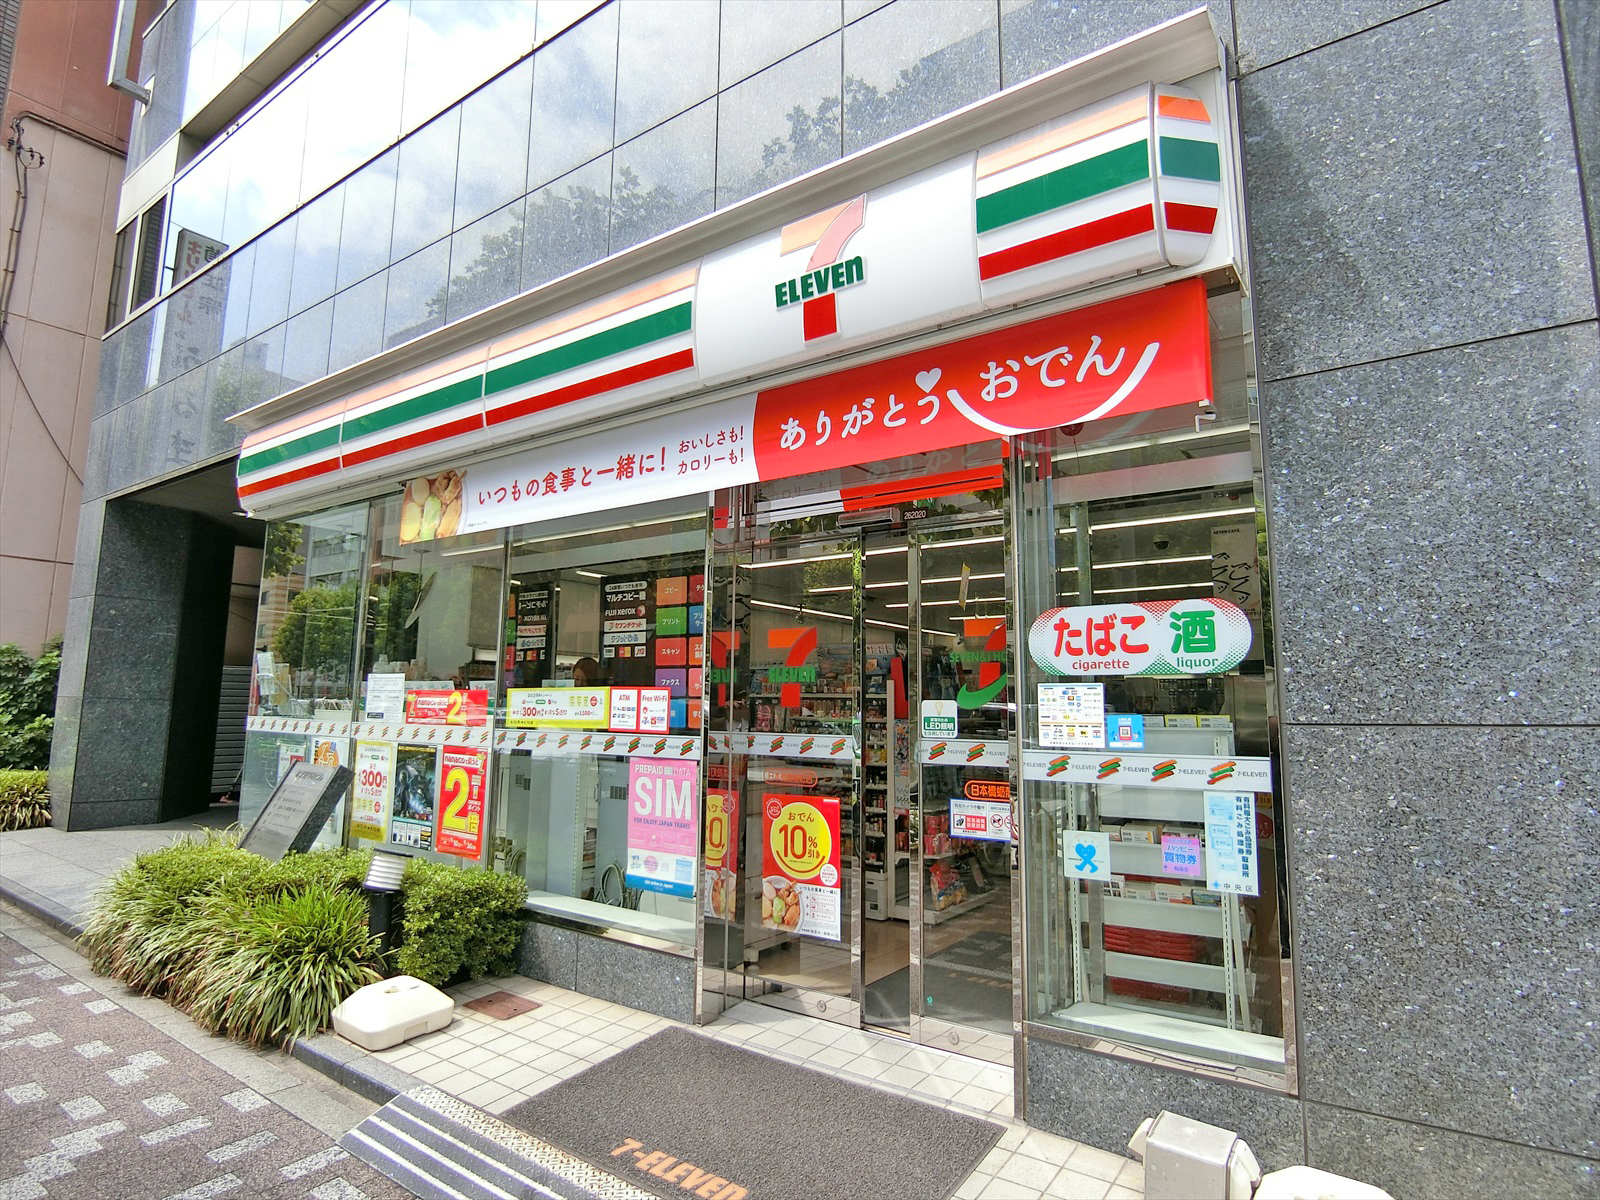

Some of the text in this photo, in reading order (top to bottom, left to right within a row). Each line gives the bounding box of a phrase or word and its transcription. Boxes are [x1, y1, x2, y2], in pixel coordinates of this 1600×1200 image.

[780, 193, 866, 342] 7
[780, 334, 1126, 452] ありがとう おでん
[678, 425, 744, 454] おいしさも！
[677, 447, 744, 476] カロリーも！
[478, 446, 666, 505] いつもの食事と一緒に！
[903, 510, 927, 520] 262020
[617, 608, 637, 616] xerox
[1053, 612, 1150, 658] たばこ
[1169, 609, 1217, 655] 酒
[768, 626, 818, 709] 7
[1072, 659, 1130, 671] cigarette
[1176, 656, 1219, 669] liquor
[654, 694, 667, 702] Wi-Fi
[924, 722, 954, 730] LED照明
[634, 763, 664, 775] PREPAID
[673, 766, 691, 777] DATA
[442, 766, 470, 832] 2
[634, 775, 692, 820] SIM
[643, 818, 658, 826] ENJOY
[787, 811, 815, 823] おでん
[1235, 795, 1245, 855] 有料ごみ処理券
[1167, 844, 1194, 853] ハッピー
[1163, 851, 1197, 865] 買物券
[1223, 883, 1253, 892] 中央区
